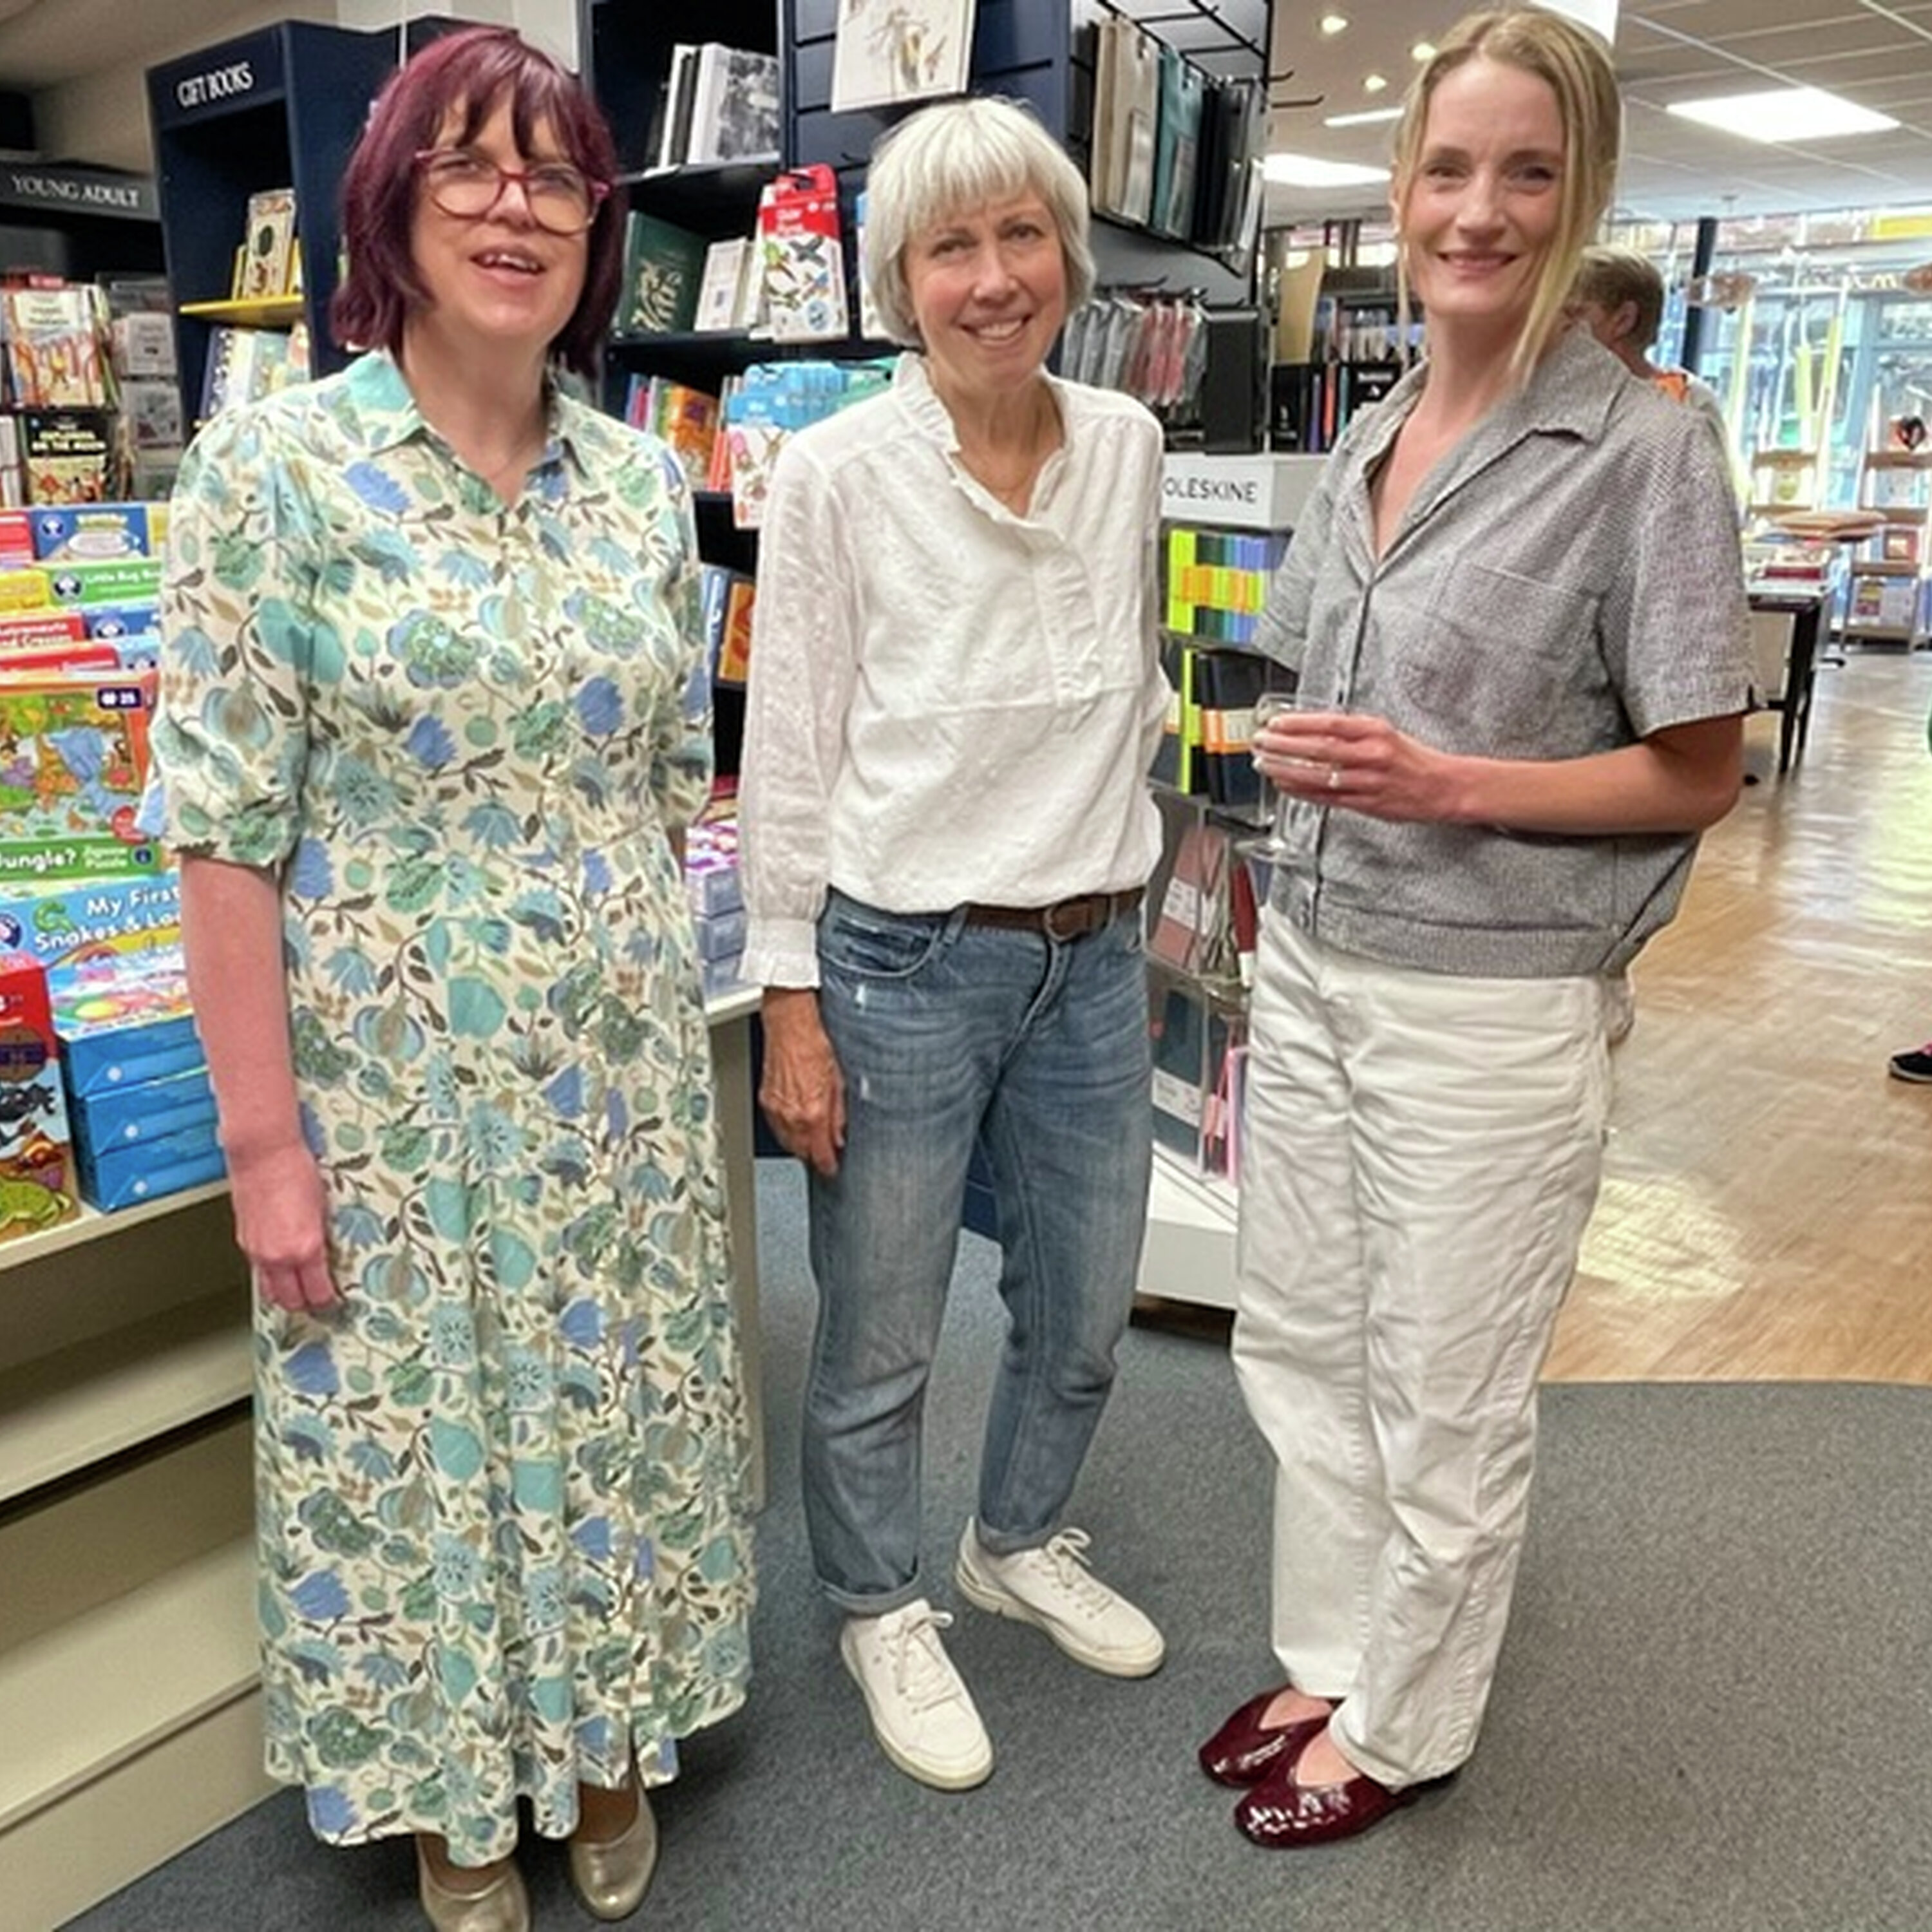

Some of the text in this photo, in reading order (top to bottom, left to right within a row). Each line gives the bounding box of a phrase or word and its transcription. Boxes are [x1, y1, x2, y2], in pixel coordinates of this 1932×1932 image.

[177, 62, 254, 107] GIFT BOOKS
[11, 175, 139, 208] YOUNG ADULT
[1162, 476, 1258, 504] OLESKINE
[84, 571, 116, 584] Little
[86, 885, 181, 917] My First
[34, 922, 119, 953] Snakes
